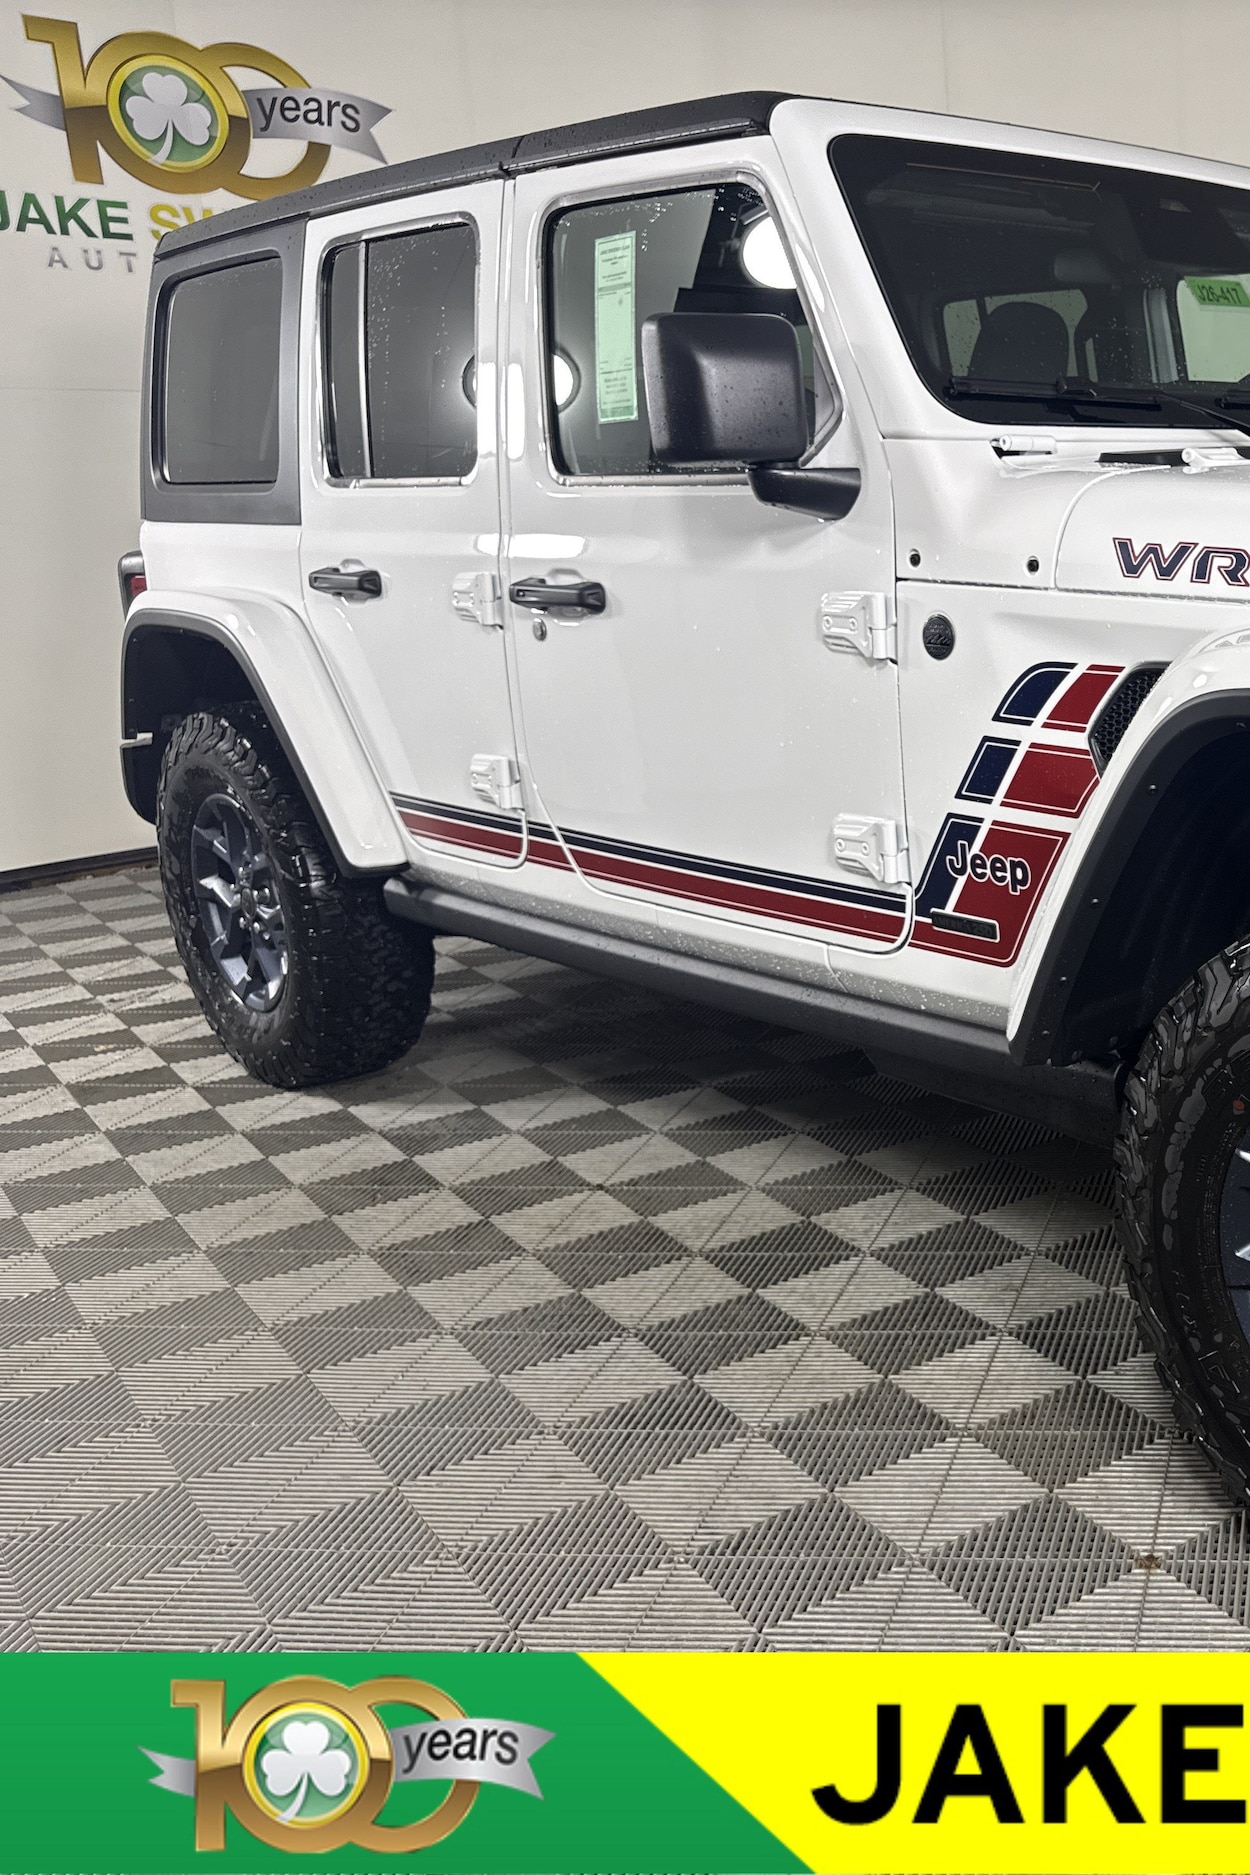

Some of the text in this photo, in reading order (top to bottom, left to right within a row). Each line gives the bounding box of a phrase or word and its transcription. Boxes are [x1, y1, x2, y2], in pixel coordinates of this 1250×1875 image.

[21, 14, 361, 200] 100 years
[947, 841, 1031, 894] Jeep
